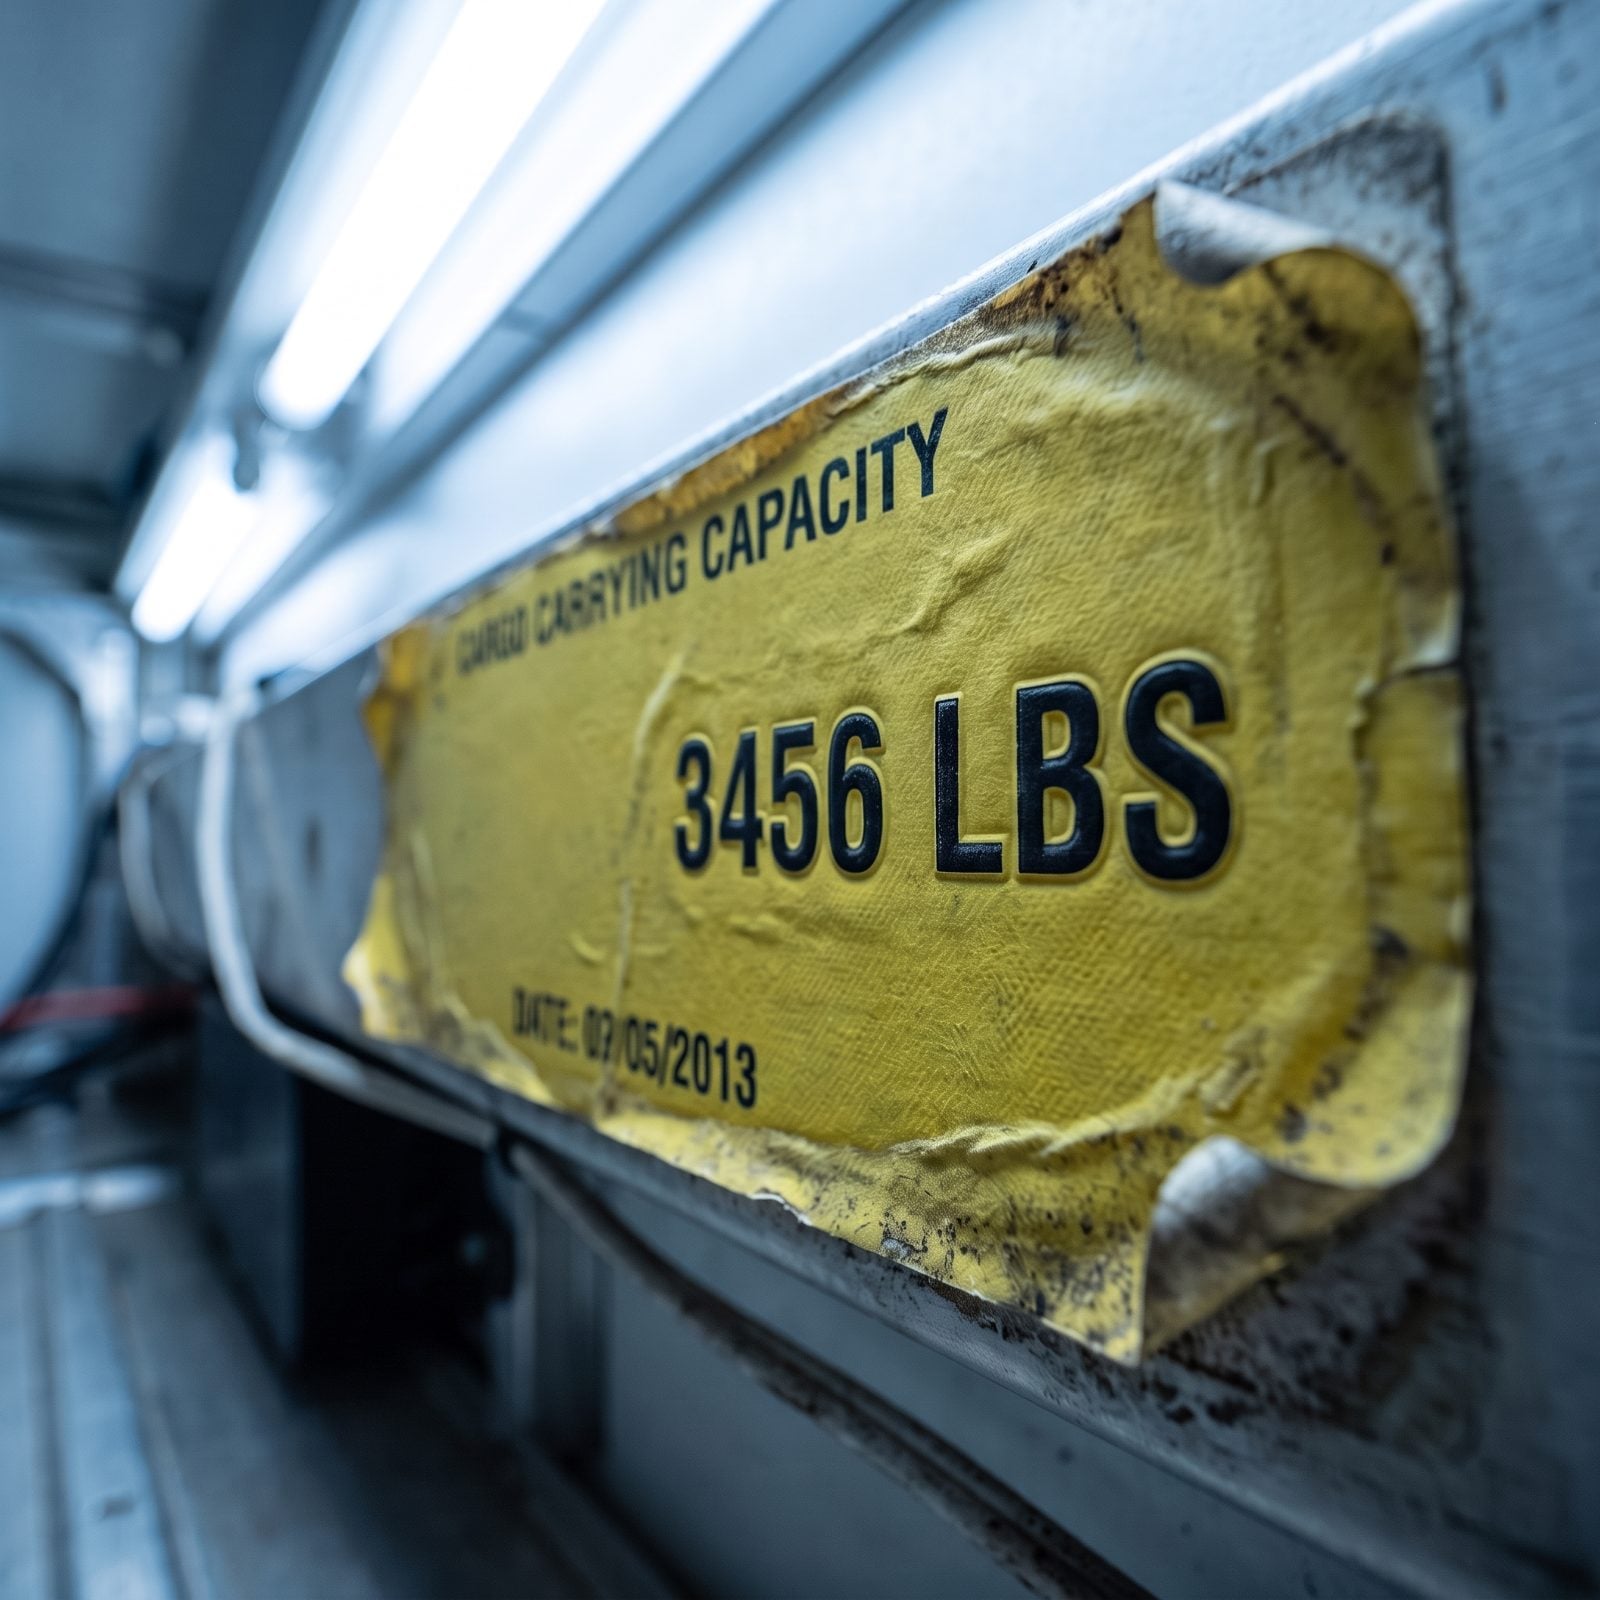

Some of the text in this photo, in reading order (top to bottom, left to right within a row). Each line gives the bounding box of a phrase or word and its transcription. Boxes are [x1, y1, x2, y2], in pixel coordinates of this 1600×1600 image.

[457, 408, 949, 674] CARGO CARRYING CAPACITY
[675, 659, 1231, 881] 3456 LBS
